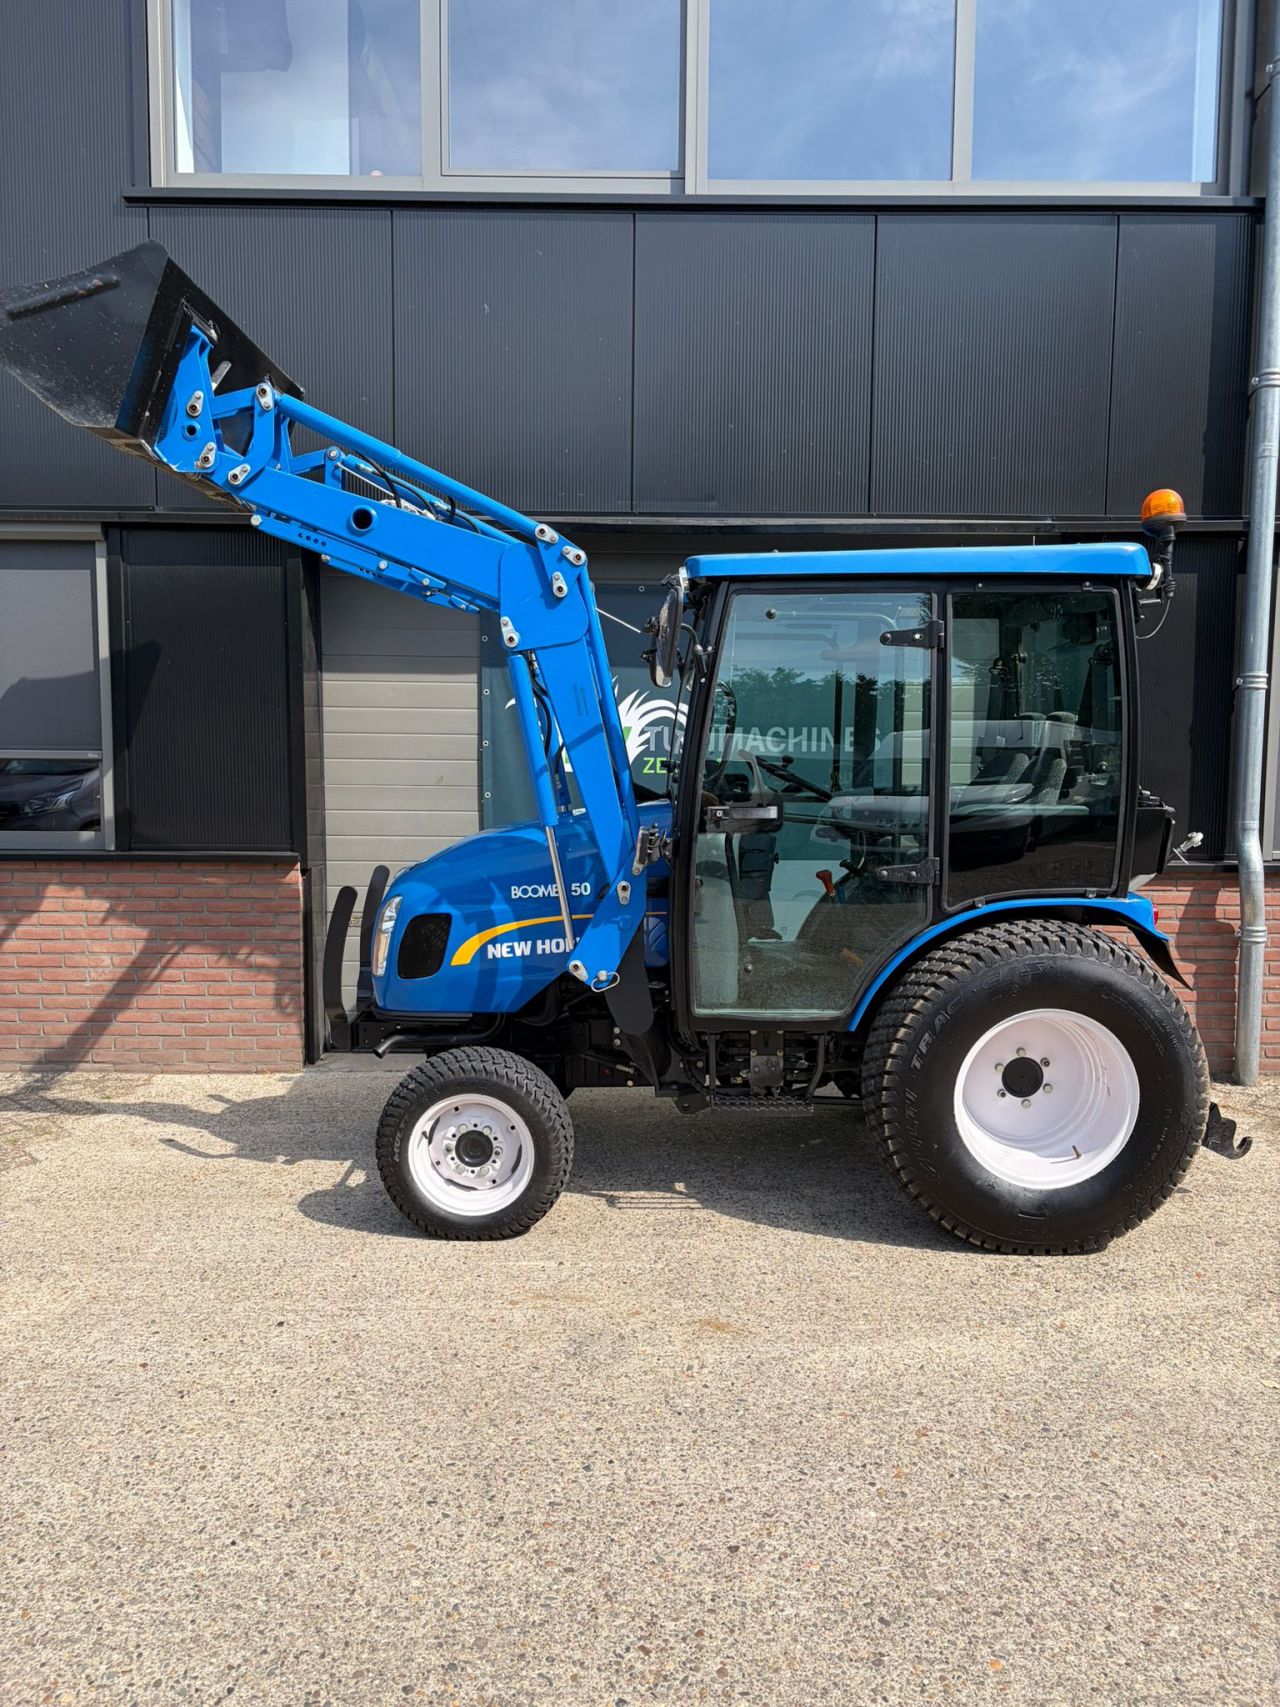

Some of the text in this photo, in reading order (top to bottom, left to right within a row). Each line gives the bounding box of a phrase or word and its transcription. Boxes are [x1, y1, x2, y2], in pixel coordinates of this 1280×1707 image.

[511, 882, 591, 899] BOOME 50
[487, 940, 532, 959] NEW
